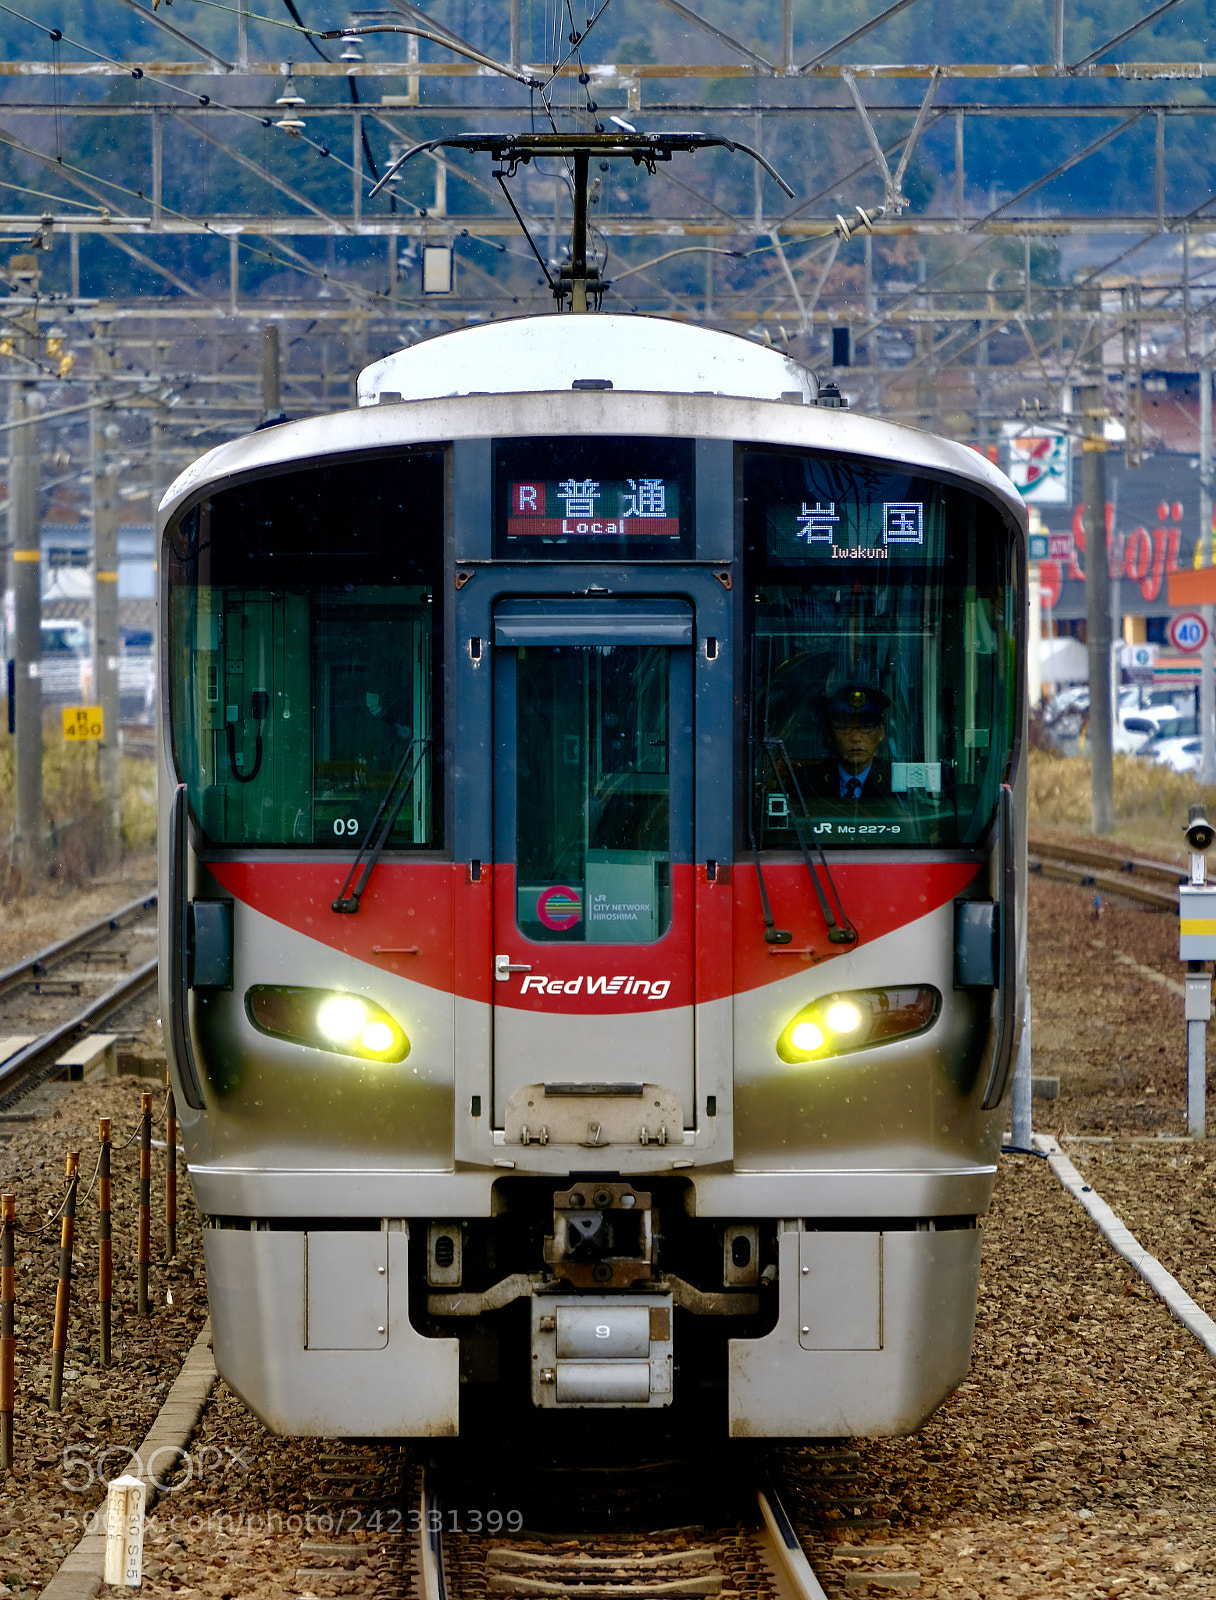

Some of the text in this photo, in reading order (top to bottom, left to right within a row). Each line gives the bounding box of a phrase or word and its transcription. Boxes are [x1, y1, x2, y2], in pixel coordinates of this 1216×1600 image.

[519, 486, 538, 511] R
[557, 478, 667, 518] 普通
[562, 519, 624, 534] Local
[796, 501, 924, 544] 岩国
[831, 545, 889, 559] Iwakuni
[1179, 624, 1200, 642] 40
[67, 724, 102, 736] 450
[333, 818, 359, 836] 09
[813, 822, 901, 834] JR Mc 227-9
[594, 894, 607, 902] JR
[593, 903, 650, 912] CITY NETWORK
[592, 912, 638, 921] HIROSHIMA
[594, 1325, 611, 1339] 9
